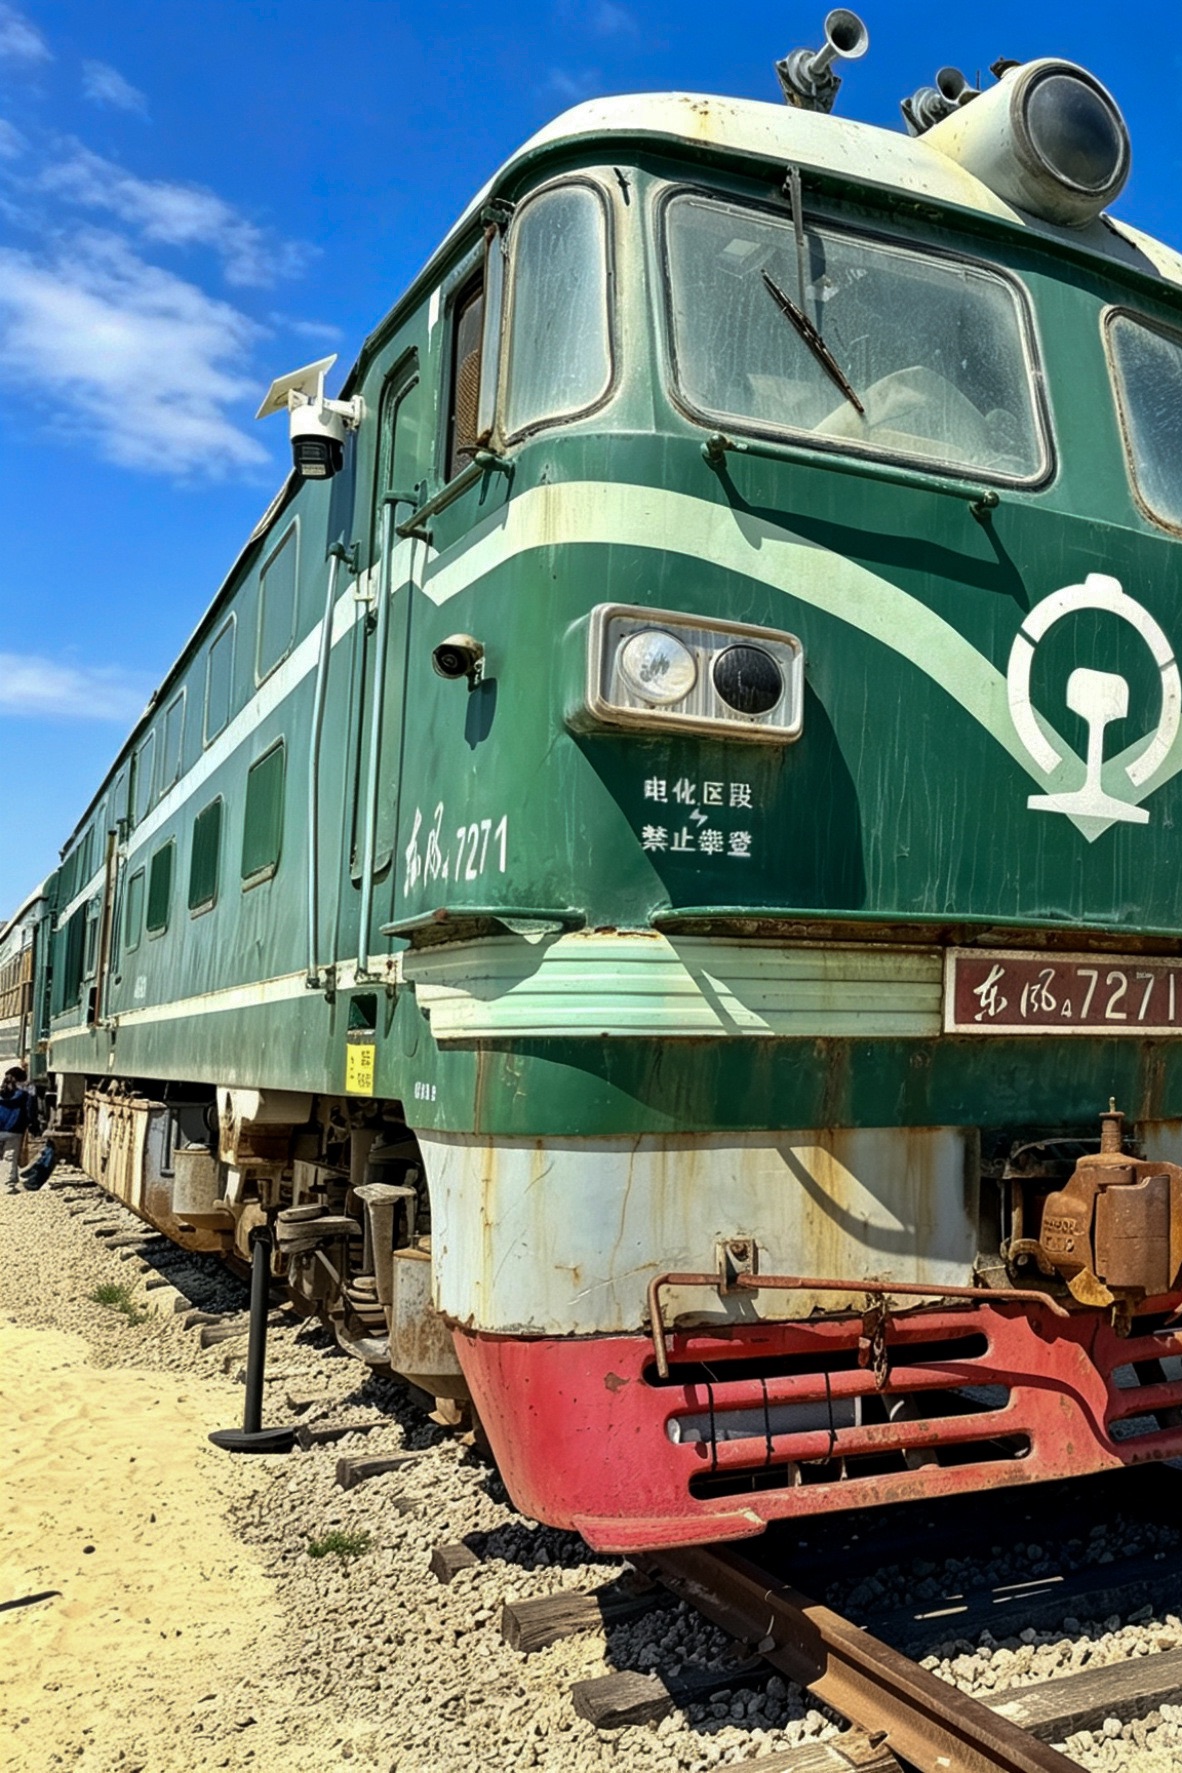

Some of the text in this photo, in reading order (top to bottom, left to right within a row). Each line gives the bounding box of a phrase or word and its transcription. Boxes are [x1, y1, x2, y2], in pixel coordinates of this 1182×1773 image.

[643, 776, 753, 809] 电化区段
[455, 814, 507, 883] 7271
[1077, 968, 1175, 1021] 7271
